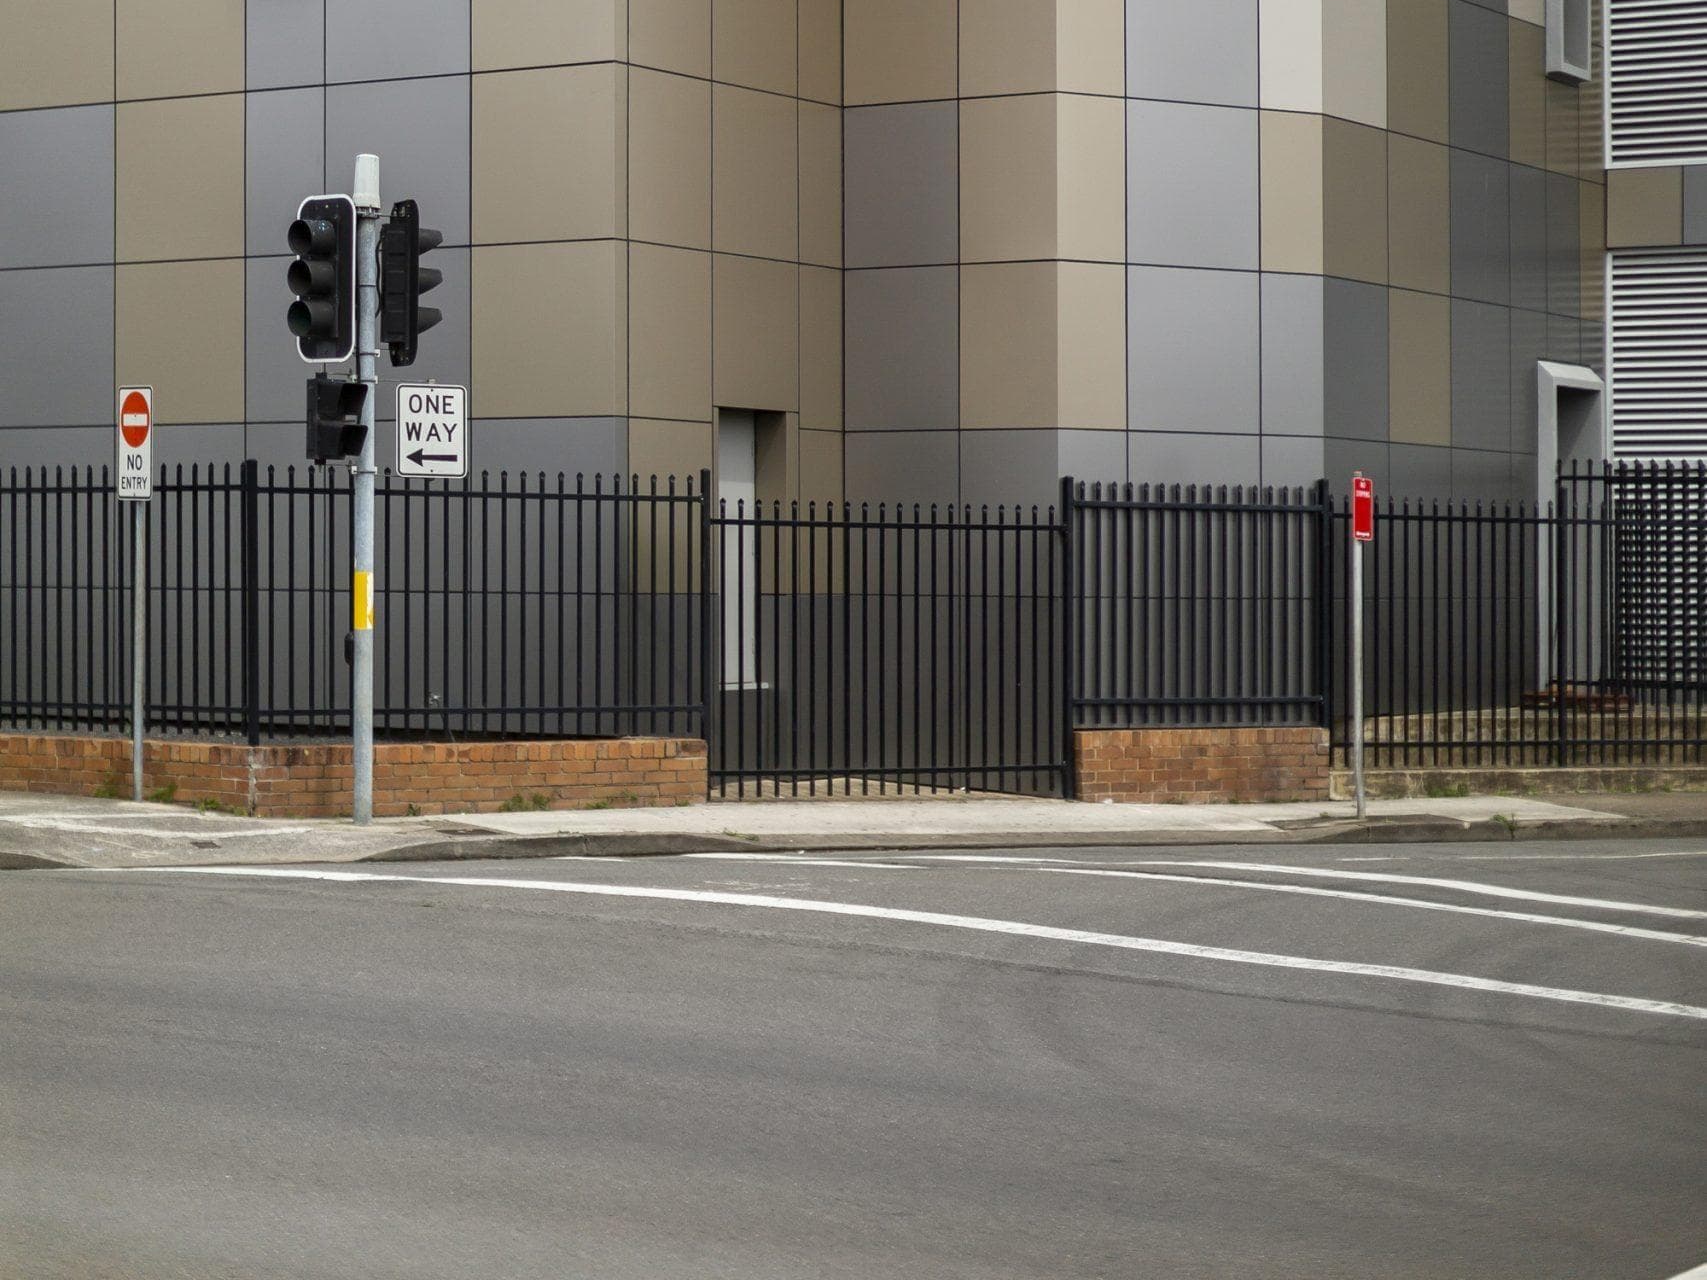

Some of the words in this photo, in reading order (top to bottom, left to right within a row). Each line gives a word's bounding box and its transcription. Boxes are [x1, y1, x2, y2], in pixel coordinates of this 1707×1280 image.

[409, 394, 455, 415] ONE
[406, 422, 458, 443] WAY
[127, 454, 143, 471] NO
[121, 476, 148, 490] ENTRY
